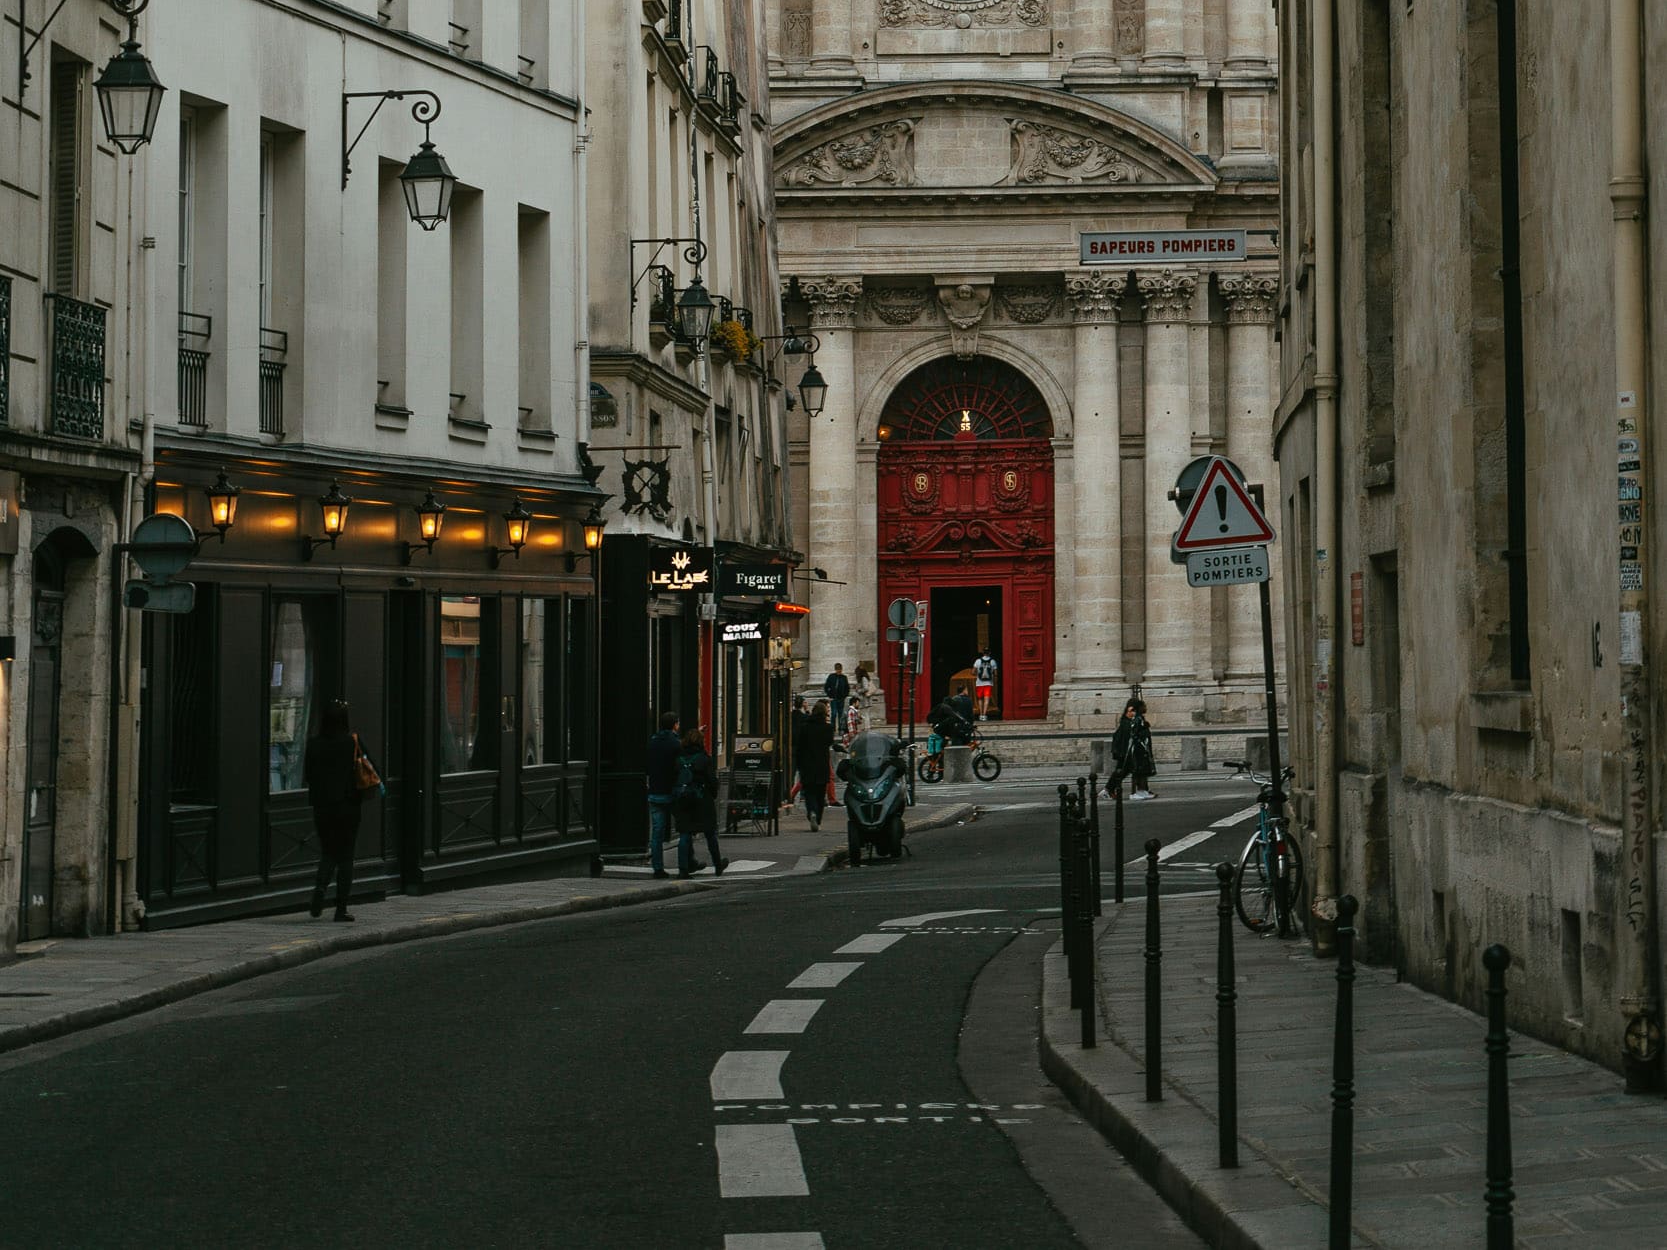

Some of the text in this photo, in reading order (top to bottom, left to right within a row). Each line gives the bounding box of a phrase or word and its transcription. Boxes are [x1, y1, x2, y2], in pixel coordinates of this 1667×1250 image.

[1090, 238, 1236, 254] SAPEURS POMPIERS
[1204, 554, 1252, 568] SORTIE
[652, 570, 671, 584] LE
[736, 573, 782, 587] Figaret
[1194, 566, 1263, 582] POMPIERS
[722, 631, 762, 641] MANIA
